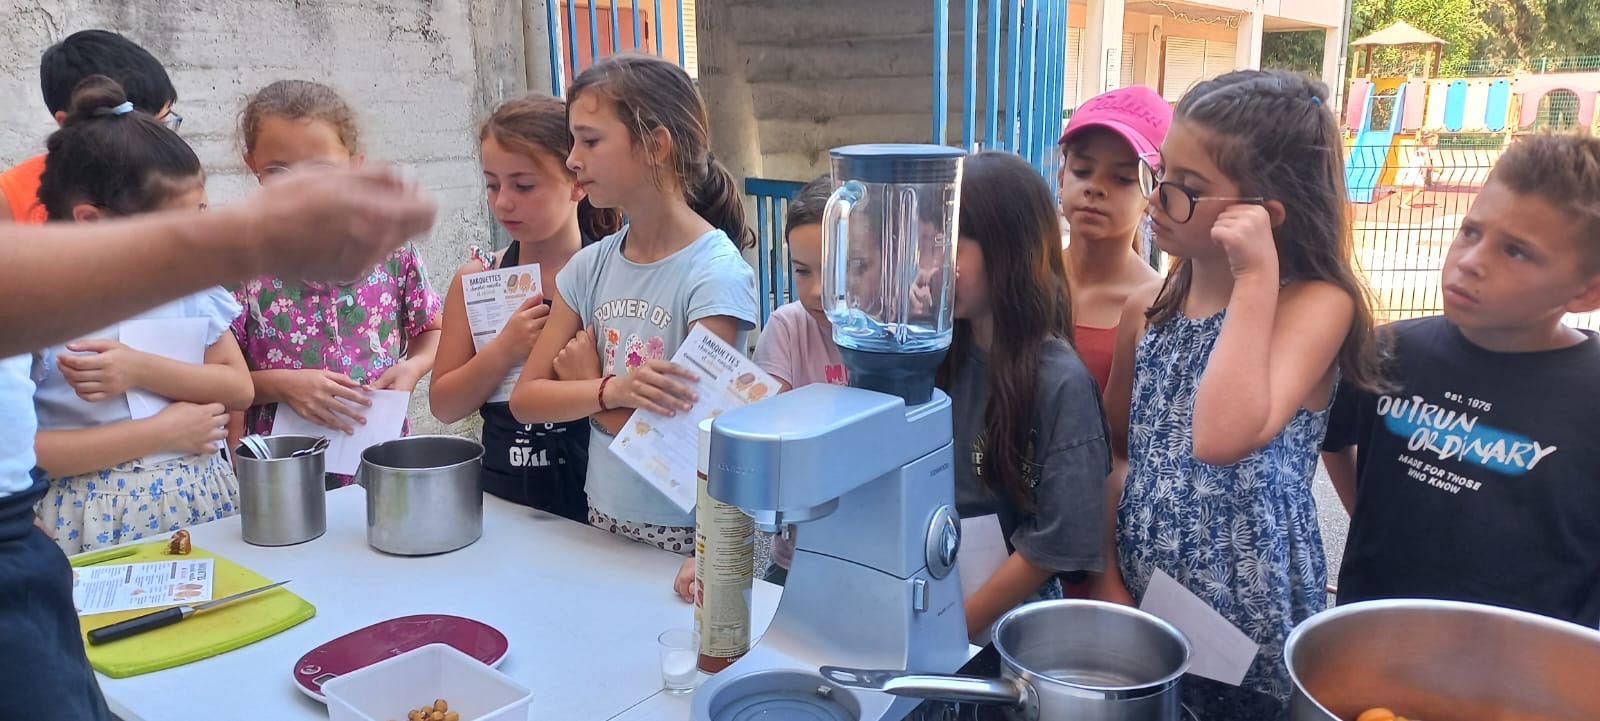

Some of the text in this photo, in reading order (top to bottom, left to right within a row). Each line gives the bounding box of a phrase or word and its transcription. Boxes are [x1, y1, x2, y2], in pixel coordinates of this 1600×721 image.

[594, 298, 673, 329] POWER OF
[702, 335, 740, 368] BARQUETTES
[1444, 391, 1463, 404] est.
[1376, 395, 1479, 433] OUTRUN
[1398, 453, 1483, 491] MADE FOR THOSE
[1407, 467, 1462, 495] WHO KNOW
